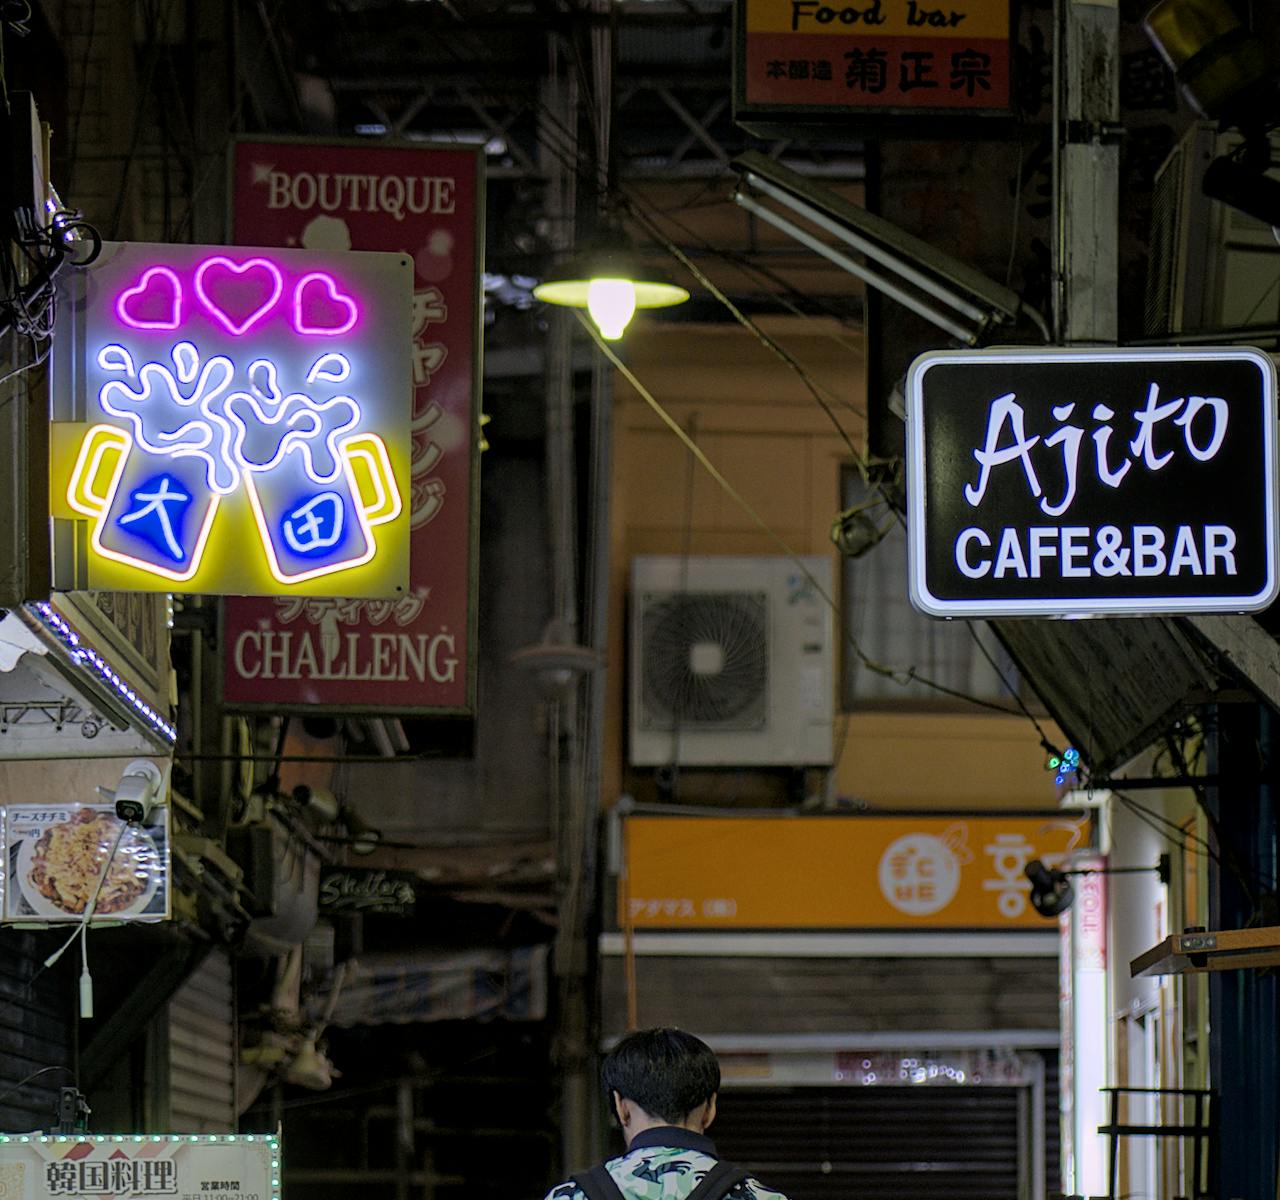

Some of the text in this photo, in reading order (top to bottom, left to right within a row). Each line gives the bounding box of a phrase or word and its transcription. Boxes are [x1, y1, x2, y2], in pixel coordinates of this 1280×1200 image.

[791, 0, 967, 28] Food bar
[844, 48, 993, 98] 菊正宗
[267, 174, 456, 219] BOUTIQUE
[964, 381, 1231, 518] Ajito
[955, 524, 1239, 580] CAFE&BAR
[233, 630, 460, 685] CHALLENG
[46, 1160, 174, 1193] 韓国料理
[200, 1180, 240, 1191] 営業時間
